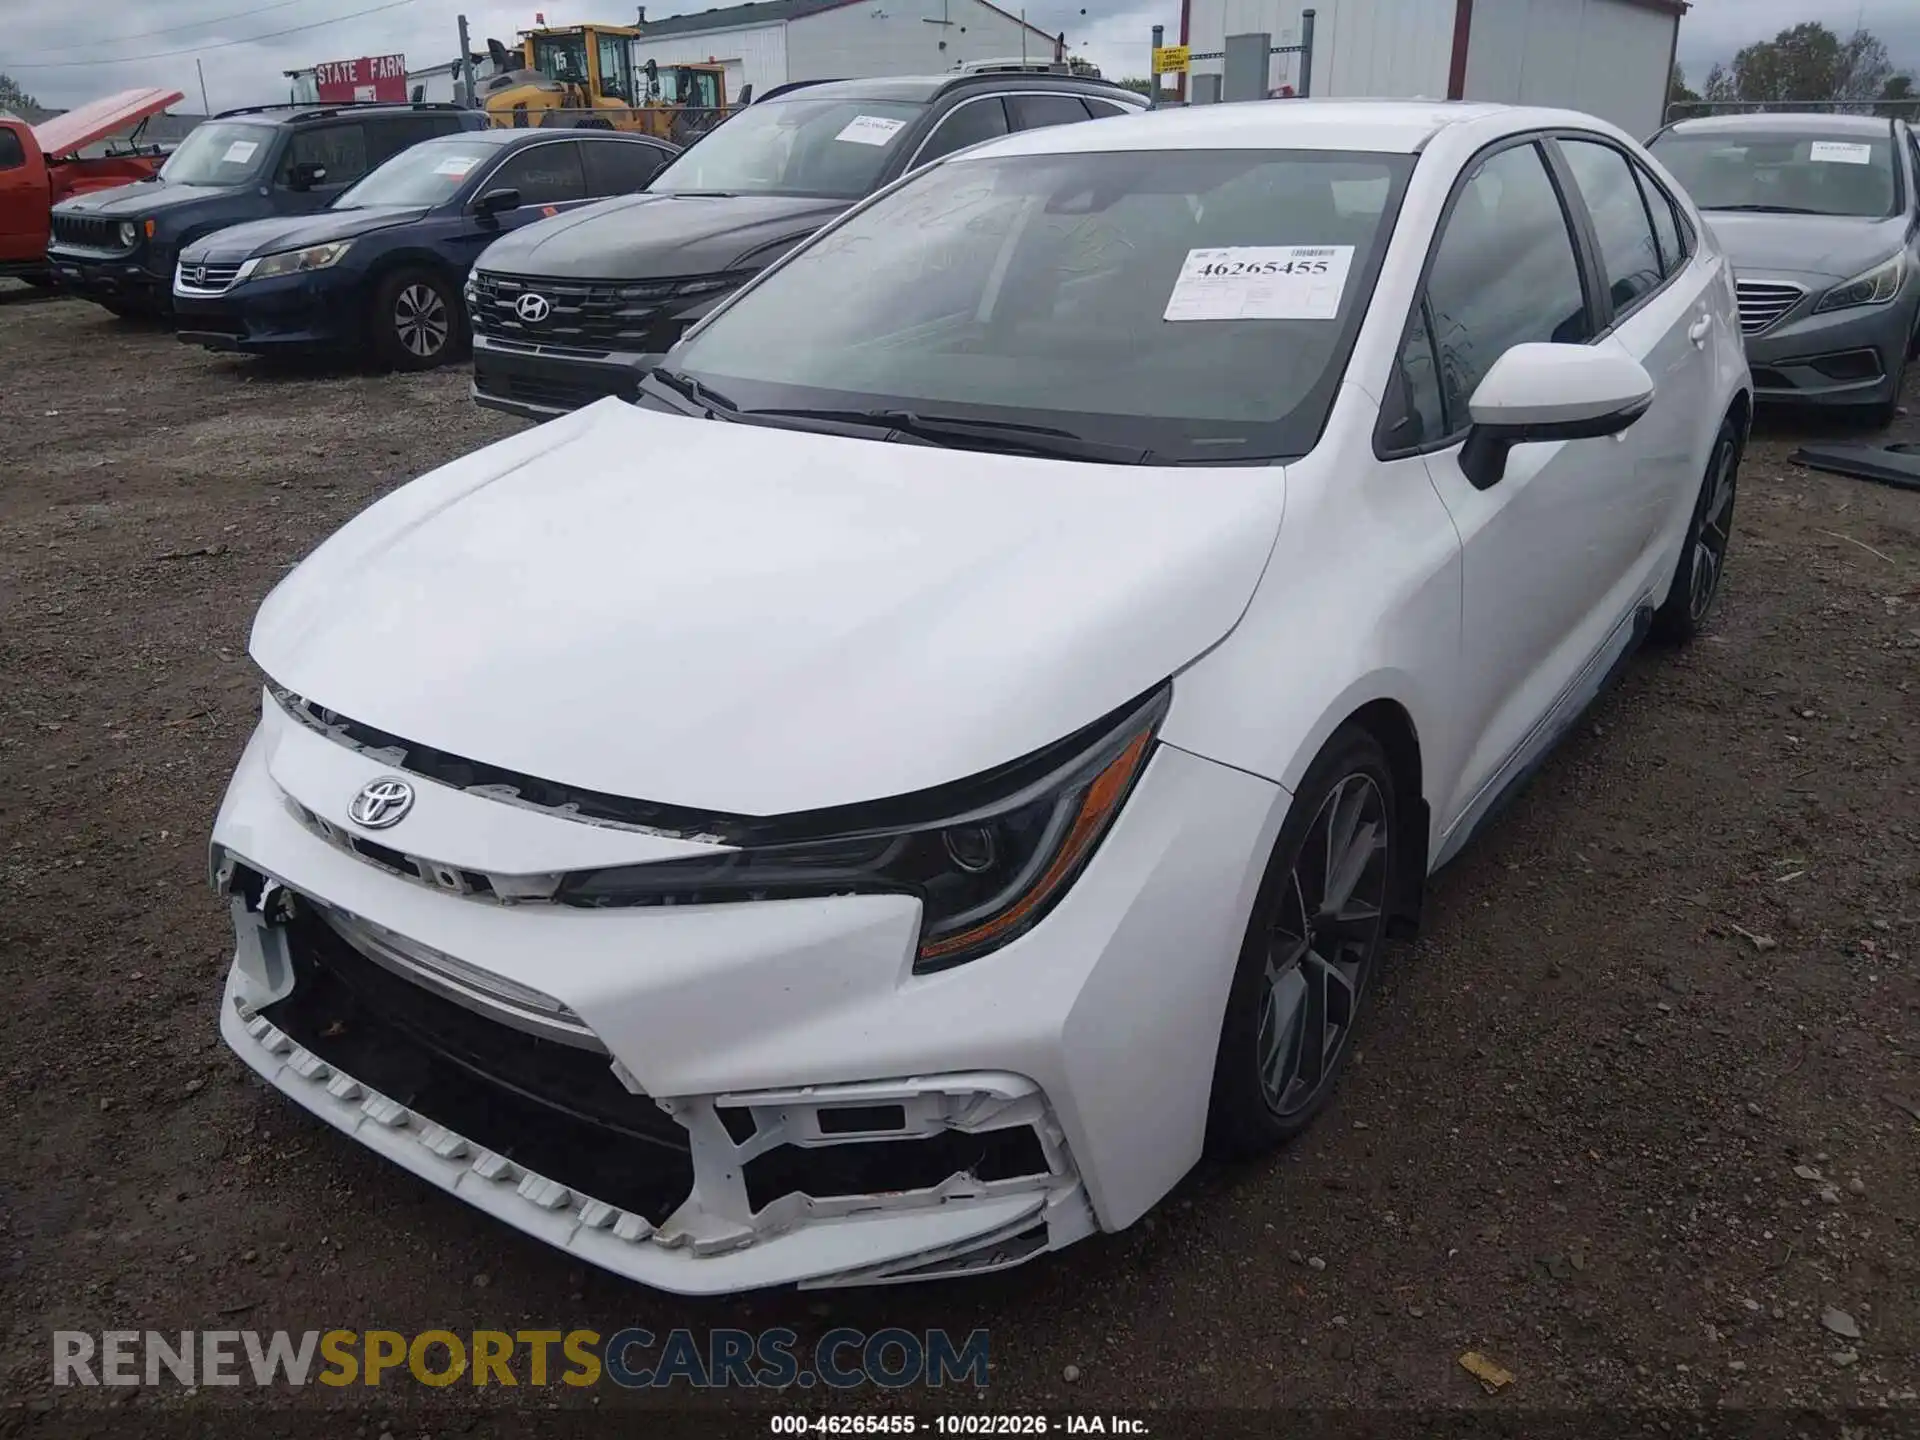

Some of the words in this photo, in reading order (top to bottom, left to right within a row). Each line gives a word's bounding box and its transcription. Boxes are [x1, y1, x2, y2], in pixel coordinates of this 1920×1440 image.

[318, 62, 358, 85] STATE
[370, 56, 405, 79] FARM
[1198, 261, 1329, 277] 46265455
